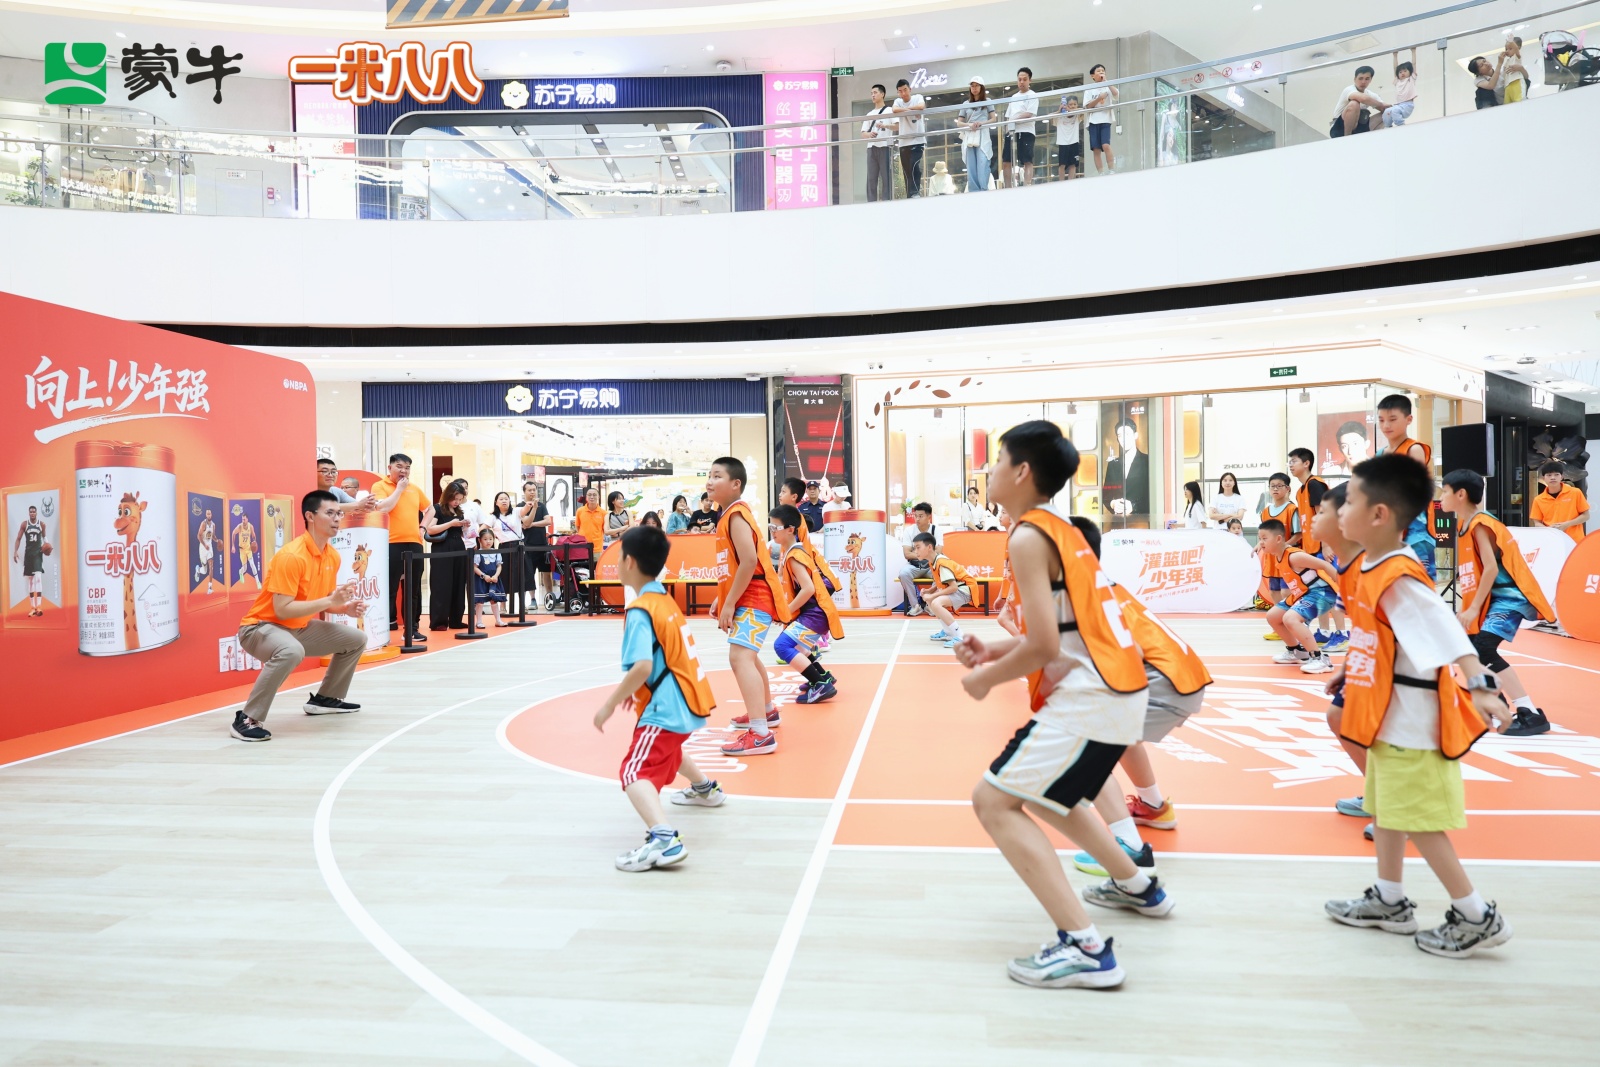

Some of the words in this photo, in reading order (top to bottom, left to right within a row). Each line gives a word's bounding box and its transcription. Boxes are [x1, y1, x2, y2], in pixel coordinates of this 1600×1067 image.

[534, 83, 616, 105] 苏宁易购
[785, 81, 819, 90] 苏宁易购
[289, 380, 308, 392] NBPA
[538, 387, 620, 409] 苏宁易购
[86, 542, 162, 578] 一米八八
[829, 556, 875, 572] 一米八八
[1141, 567, 1206, 595] 少年强
[89, 588, 105, 598] CBP
